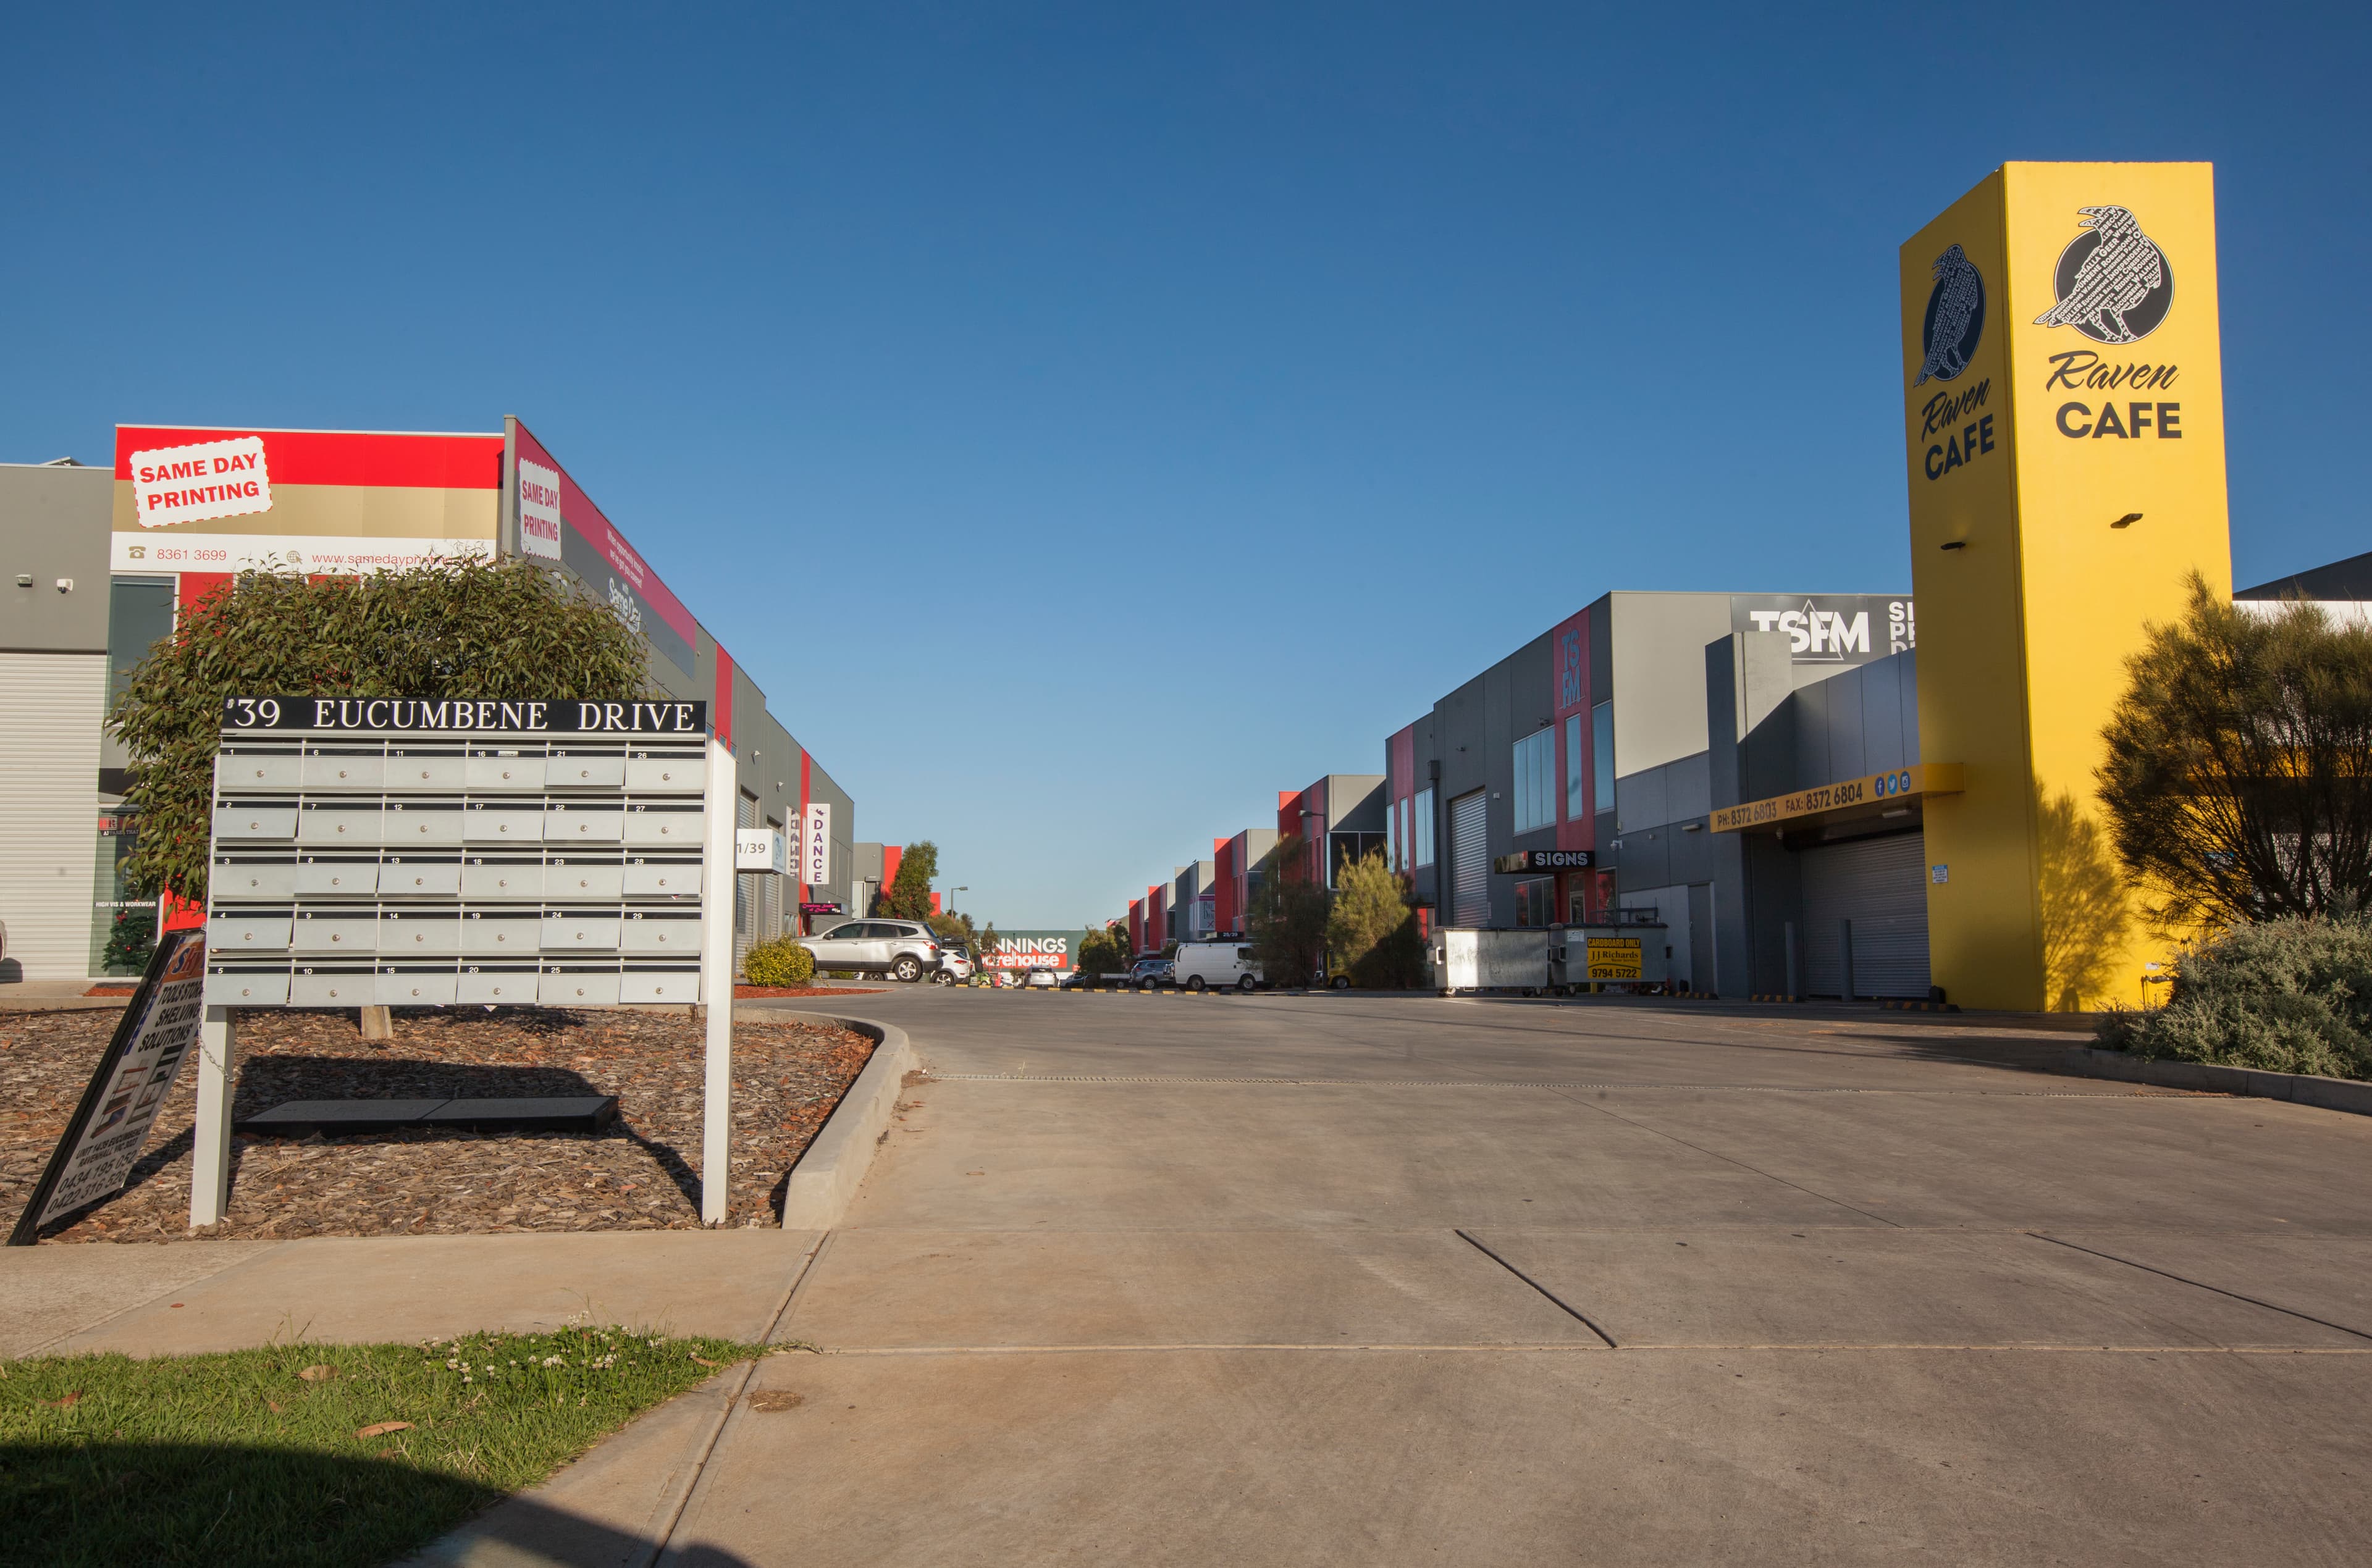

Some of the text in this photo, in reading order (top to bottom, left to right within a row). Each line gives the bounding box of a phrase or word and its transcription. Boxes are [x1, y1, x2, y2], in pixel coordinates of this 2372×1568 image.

[2046, 350, 2180, 392] Raven
[1922, 377, 1991, 443] Raven
[2056, 402, 2182, 438] CAFE
[1925, 413, 1994, 480] CAFE
[140, 453, 257, 483] SAME DAY
[148, 481, 259, 510] PRINTING
[522, 480, 558, 509] SAME DAY
[524, 514, 558, 542] PRINTING
[157, 549, 227, 561] 8361 3699
[1750, 611, 1870, 653] TSFM
[235, 699, 694, 731] 39 EUCUMBENE DRIVE
[1718, 783, 1863, 826] PH: 8372 6803 FAX: 8372 6804
[814, 820, 823, 883] DANCE
[1536, 853, 1588, 866] SIGNS
[1588, 939, 1641, 947] CARDBOARD ONLY
[1602, 950, 1638, 958] Richards
[1592, 969, 1636, 978] 9794 5722
[138, 1024, 193, 1052] SOLUTIONS
[76, 1146, 93, 1159] UNIT
[58, 1169, 92, 1194] 0434
[93, 1158, 116, 1177] 195
[48, 1189, 82, 1214] 0422
[81, 1178, 106, 1199] 316
